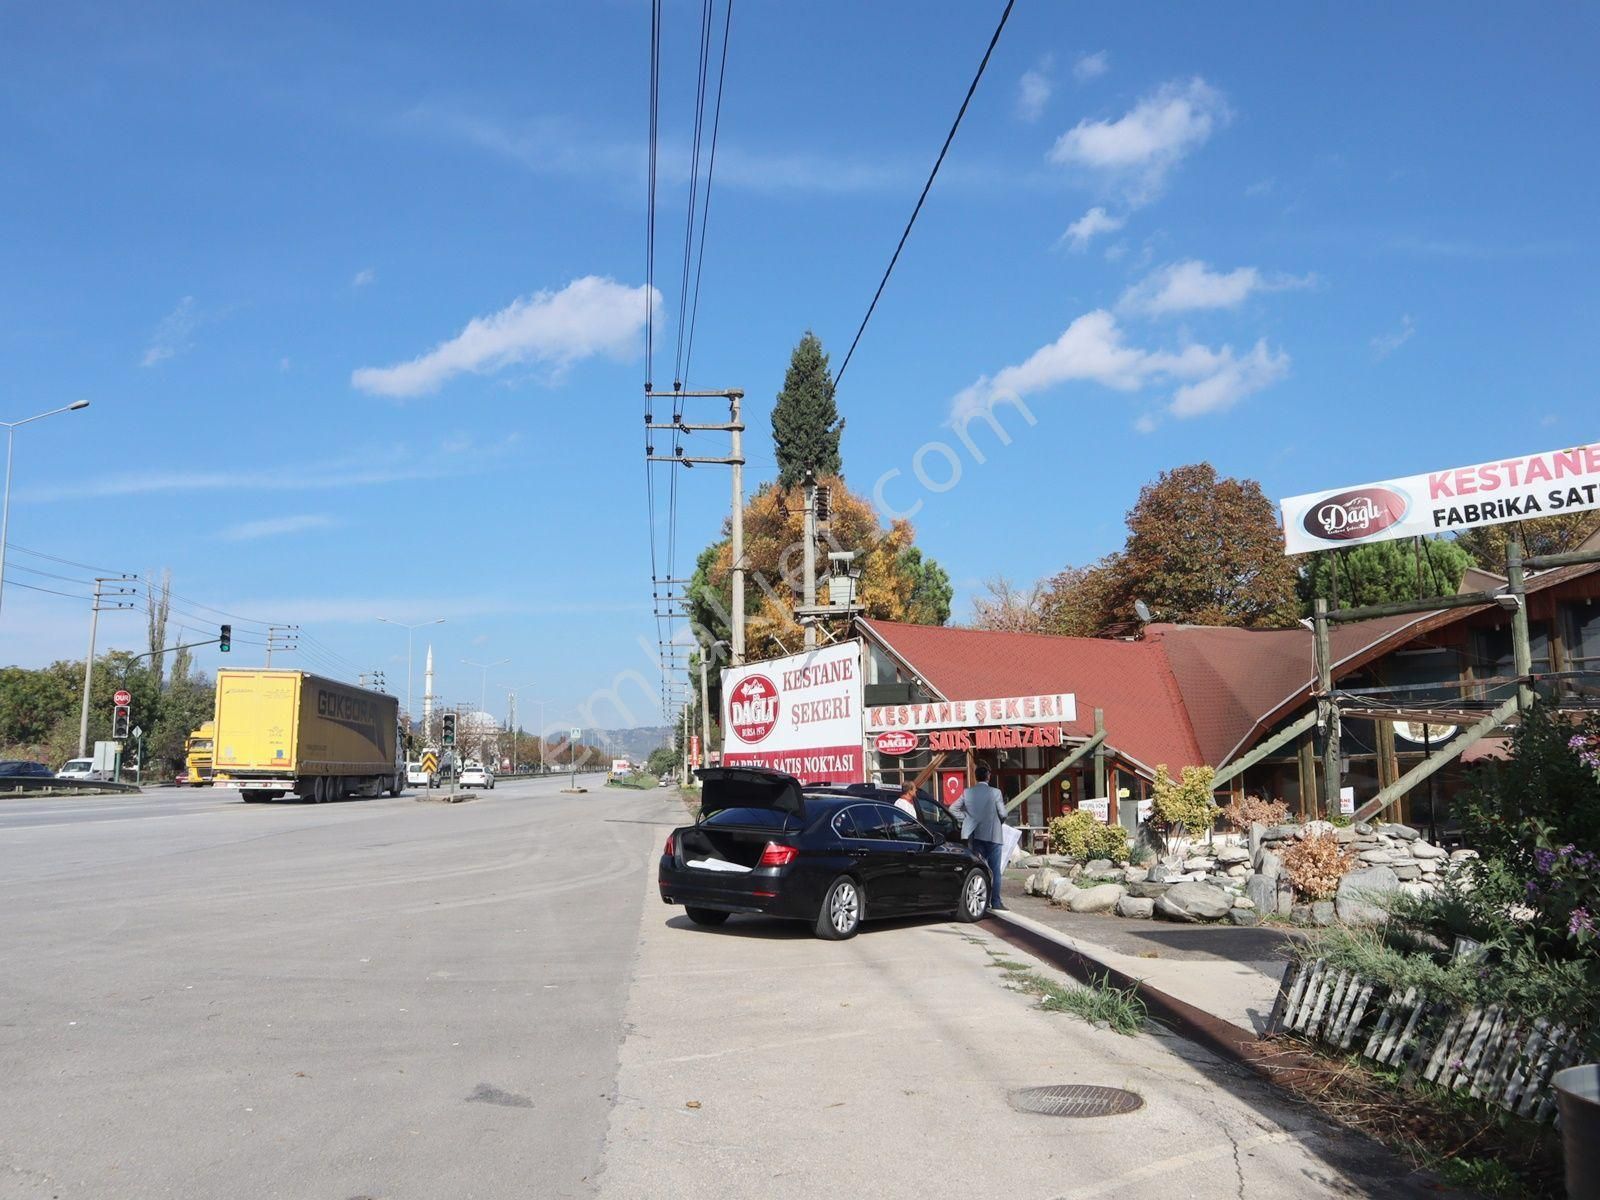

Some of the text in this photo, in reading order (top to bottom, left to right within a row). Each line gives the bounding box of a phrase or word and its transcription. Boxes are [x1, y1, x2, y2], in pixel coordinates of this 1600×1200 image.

[1428, 444, 1600, 500] KESTANE
[1548, 482, 1600, 509] SAT
[783, 658, 853, 692] KESTANE
[115, 694, 129, 702] DUR
[732, 693, 778, 726] DAĞLI
[791, 690, 851, 731] ŞEKERİ
[871, 694, 1064, 727] KESTANE ŞEKERİ
[878, 736, 914, 748] DAĞLI
[929, 724, 1061, 752] SATIŞ MAĞAZASI
[773, 757, 802, 777] SATIŞ
[804, 754, 854, 773] NOKTASI
